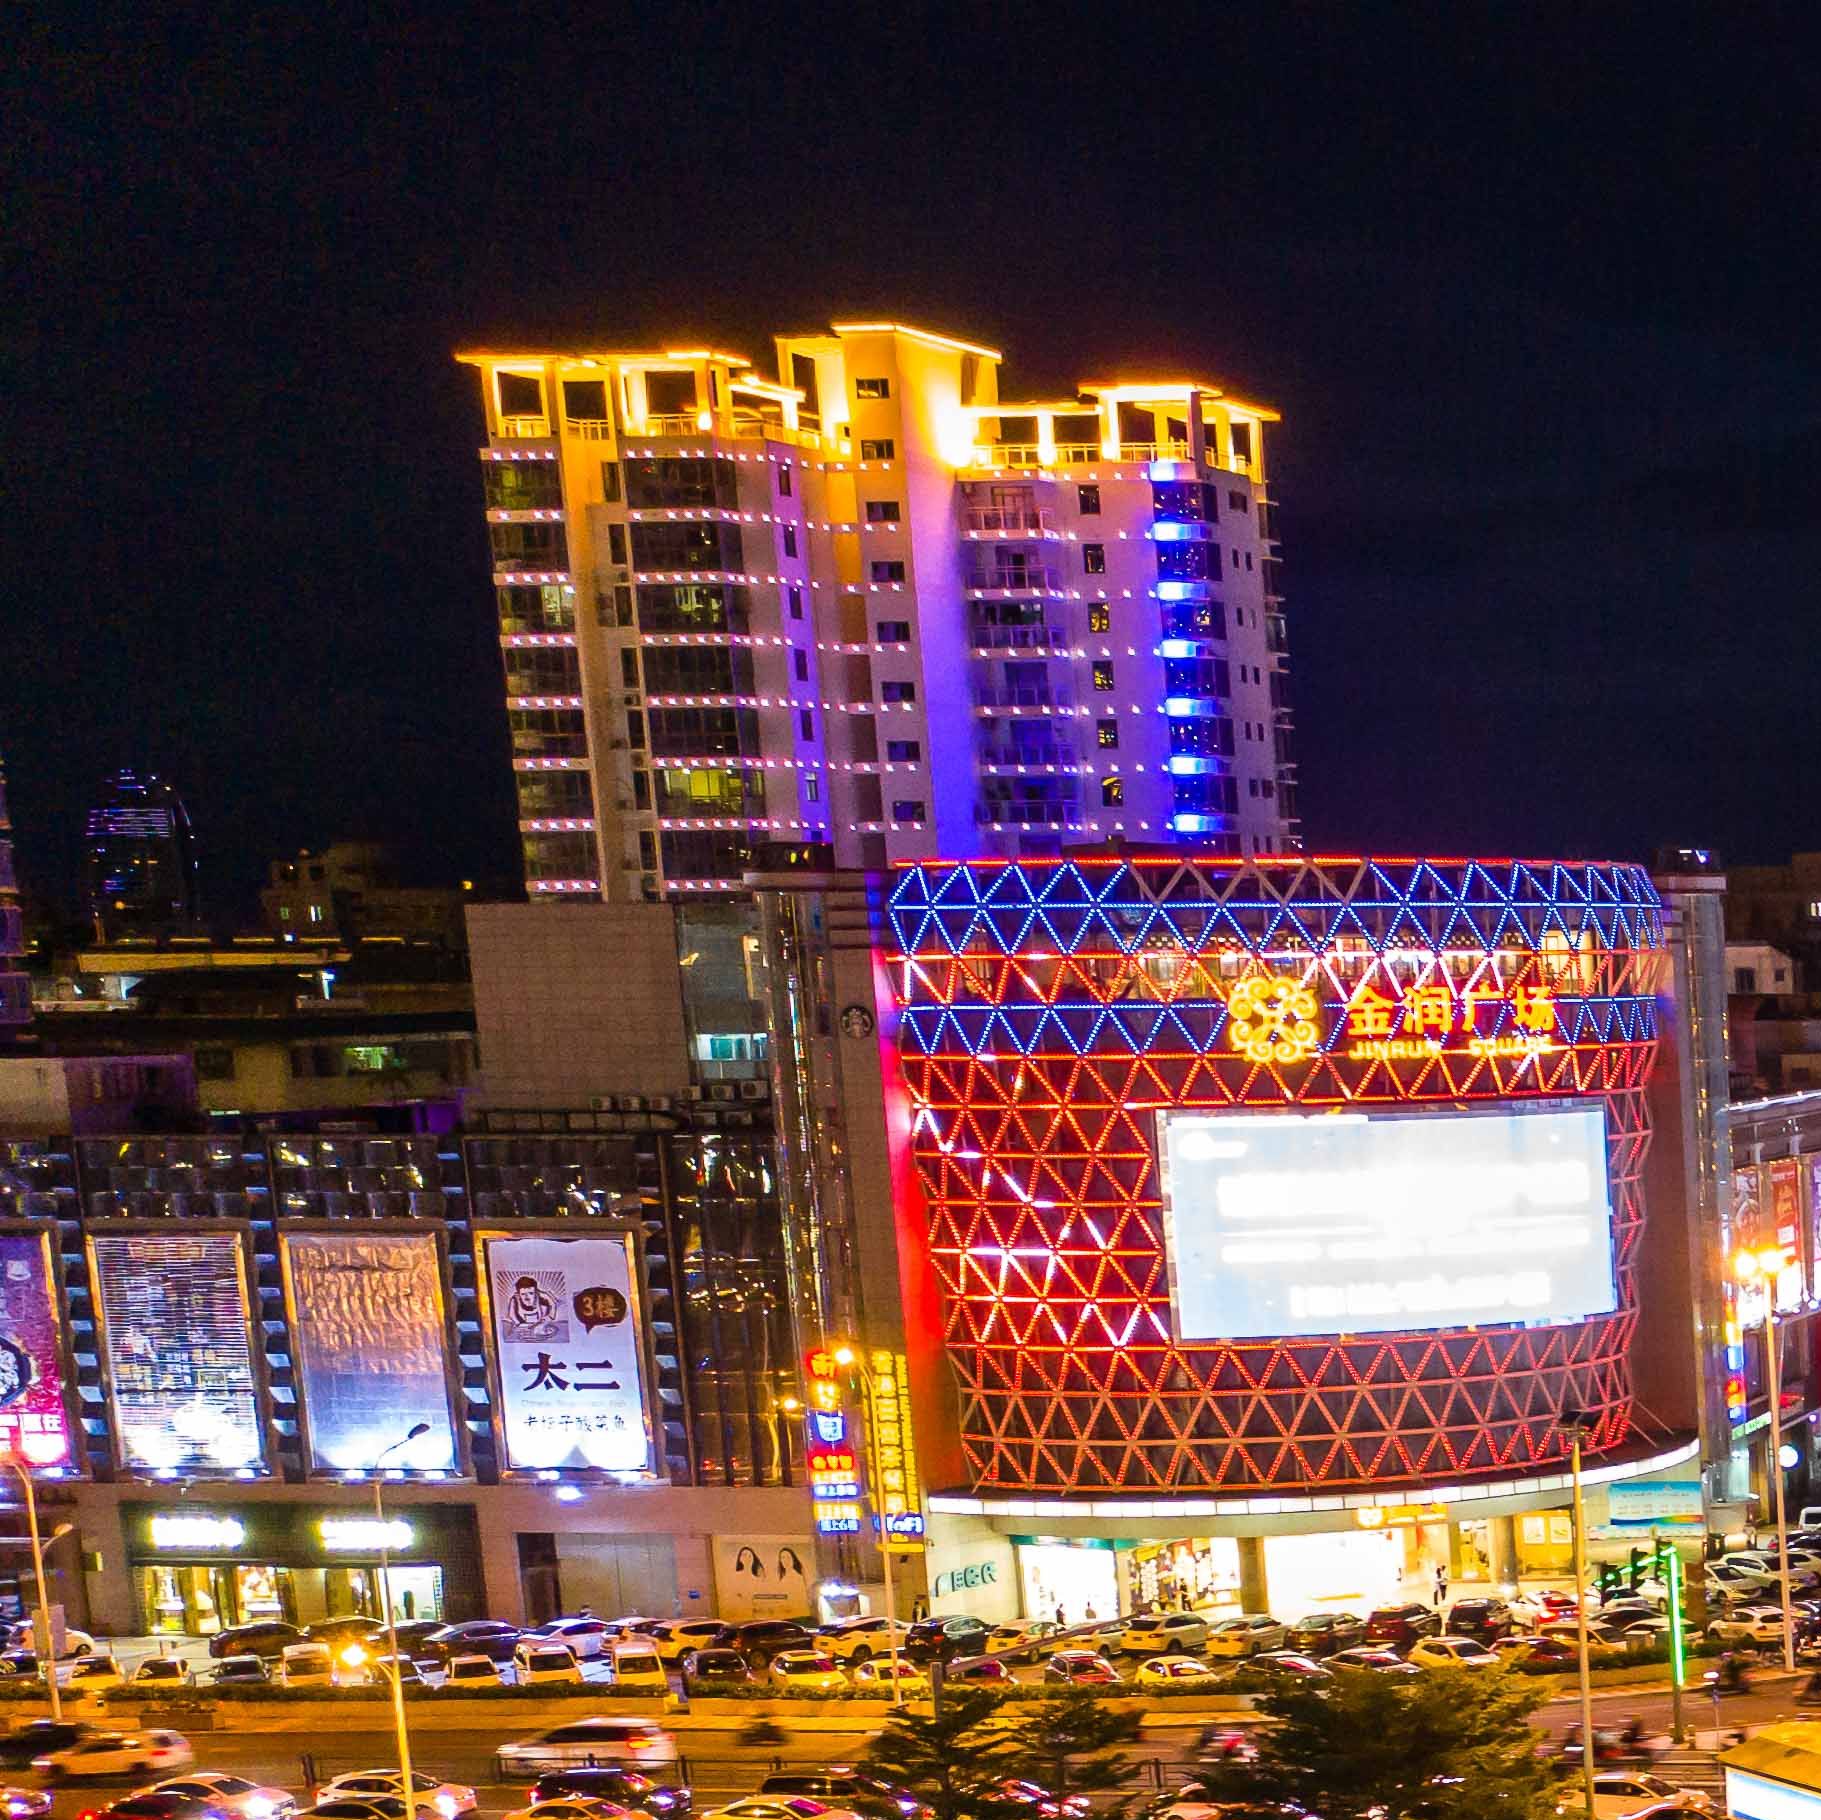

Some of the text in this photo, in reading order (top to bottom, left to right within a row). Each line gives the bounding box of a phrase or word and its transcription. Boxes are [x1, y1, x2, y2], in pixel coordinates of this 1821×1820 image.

[1347, 981, 1555, 1035] 金润广场
[1349, 1036, 1553, 1059] JINRUN SQUARE
[521, 1351, 621, 1392] 太二
